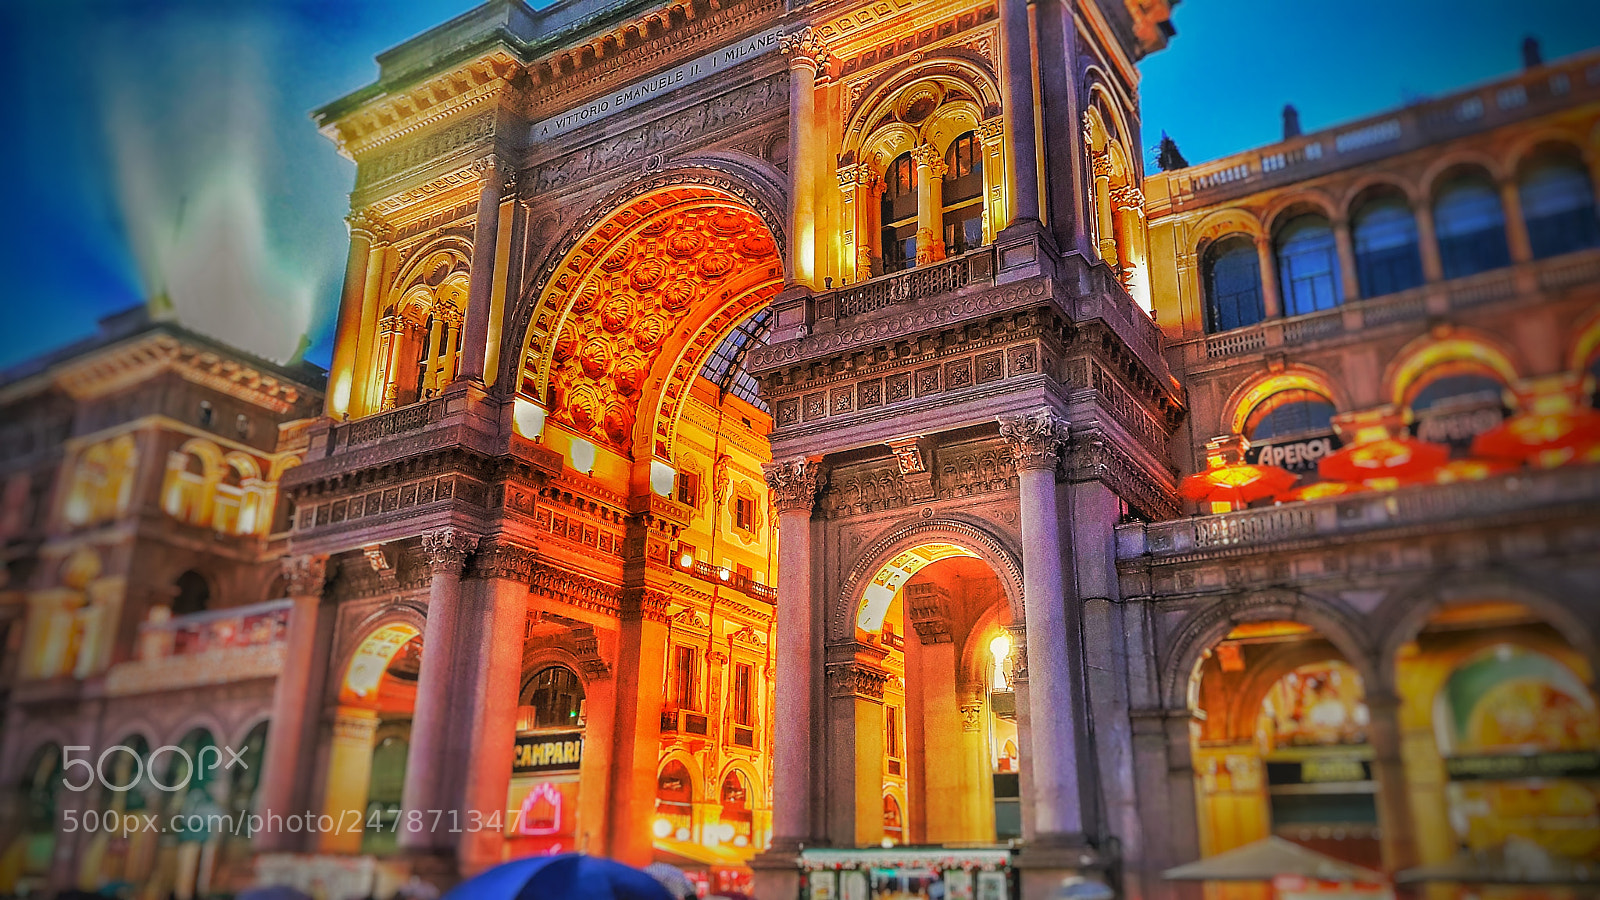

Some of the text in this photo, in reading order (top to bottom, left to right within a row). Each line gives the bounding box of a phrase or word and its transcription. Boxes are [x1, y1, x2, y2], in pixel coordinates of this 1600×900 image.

[541, 126, 549, 135] A
[555, 101, 609, 129] VITTORIO
[615, 70, 684, 106] EMANUELE
[712, 57, 717, 67] I
[1258, 438, 1335, 466] APEROL
[514, 740, 580, 767] CAMPARI
